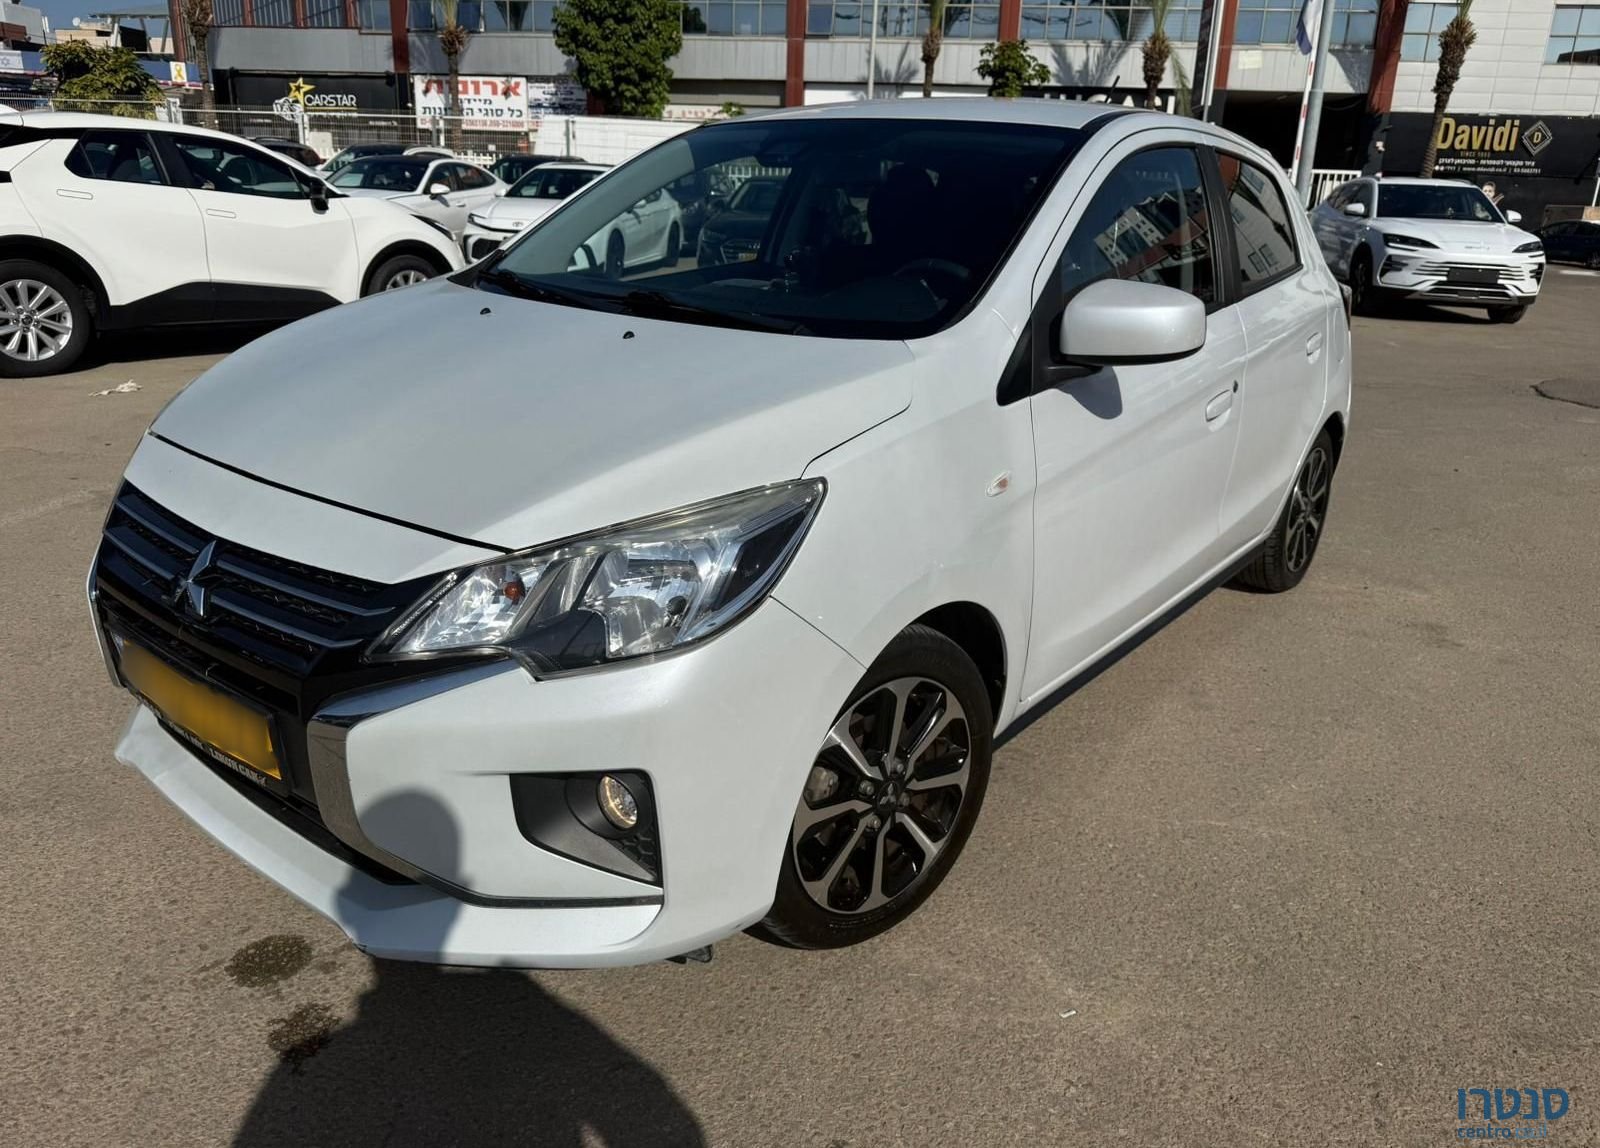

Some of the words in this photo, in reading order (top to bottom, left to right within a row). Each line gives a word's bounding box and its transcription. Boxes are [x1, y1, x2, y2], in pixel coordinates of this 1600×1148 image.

[304, 94, 357, 107] CARSTAR
[477, 107, 504, 117] סוגי
[508, 106, 523, 117] כל
[1436, 117, 1520, 151] Davidi
[1533, 131, 1542, 144] D
